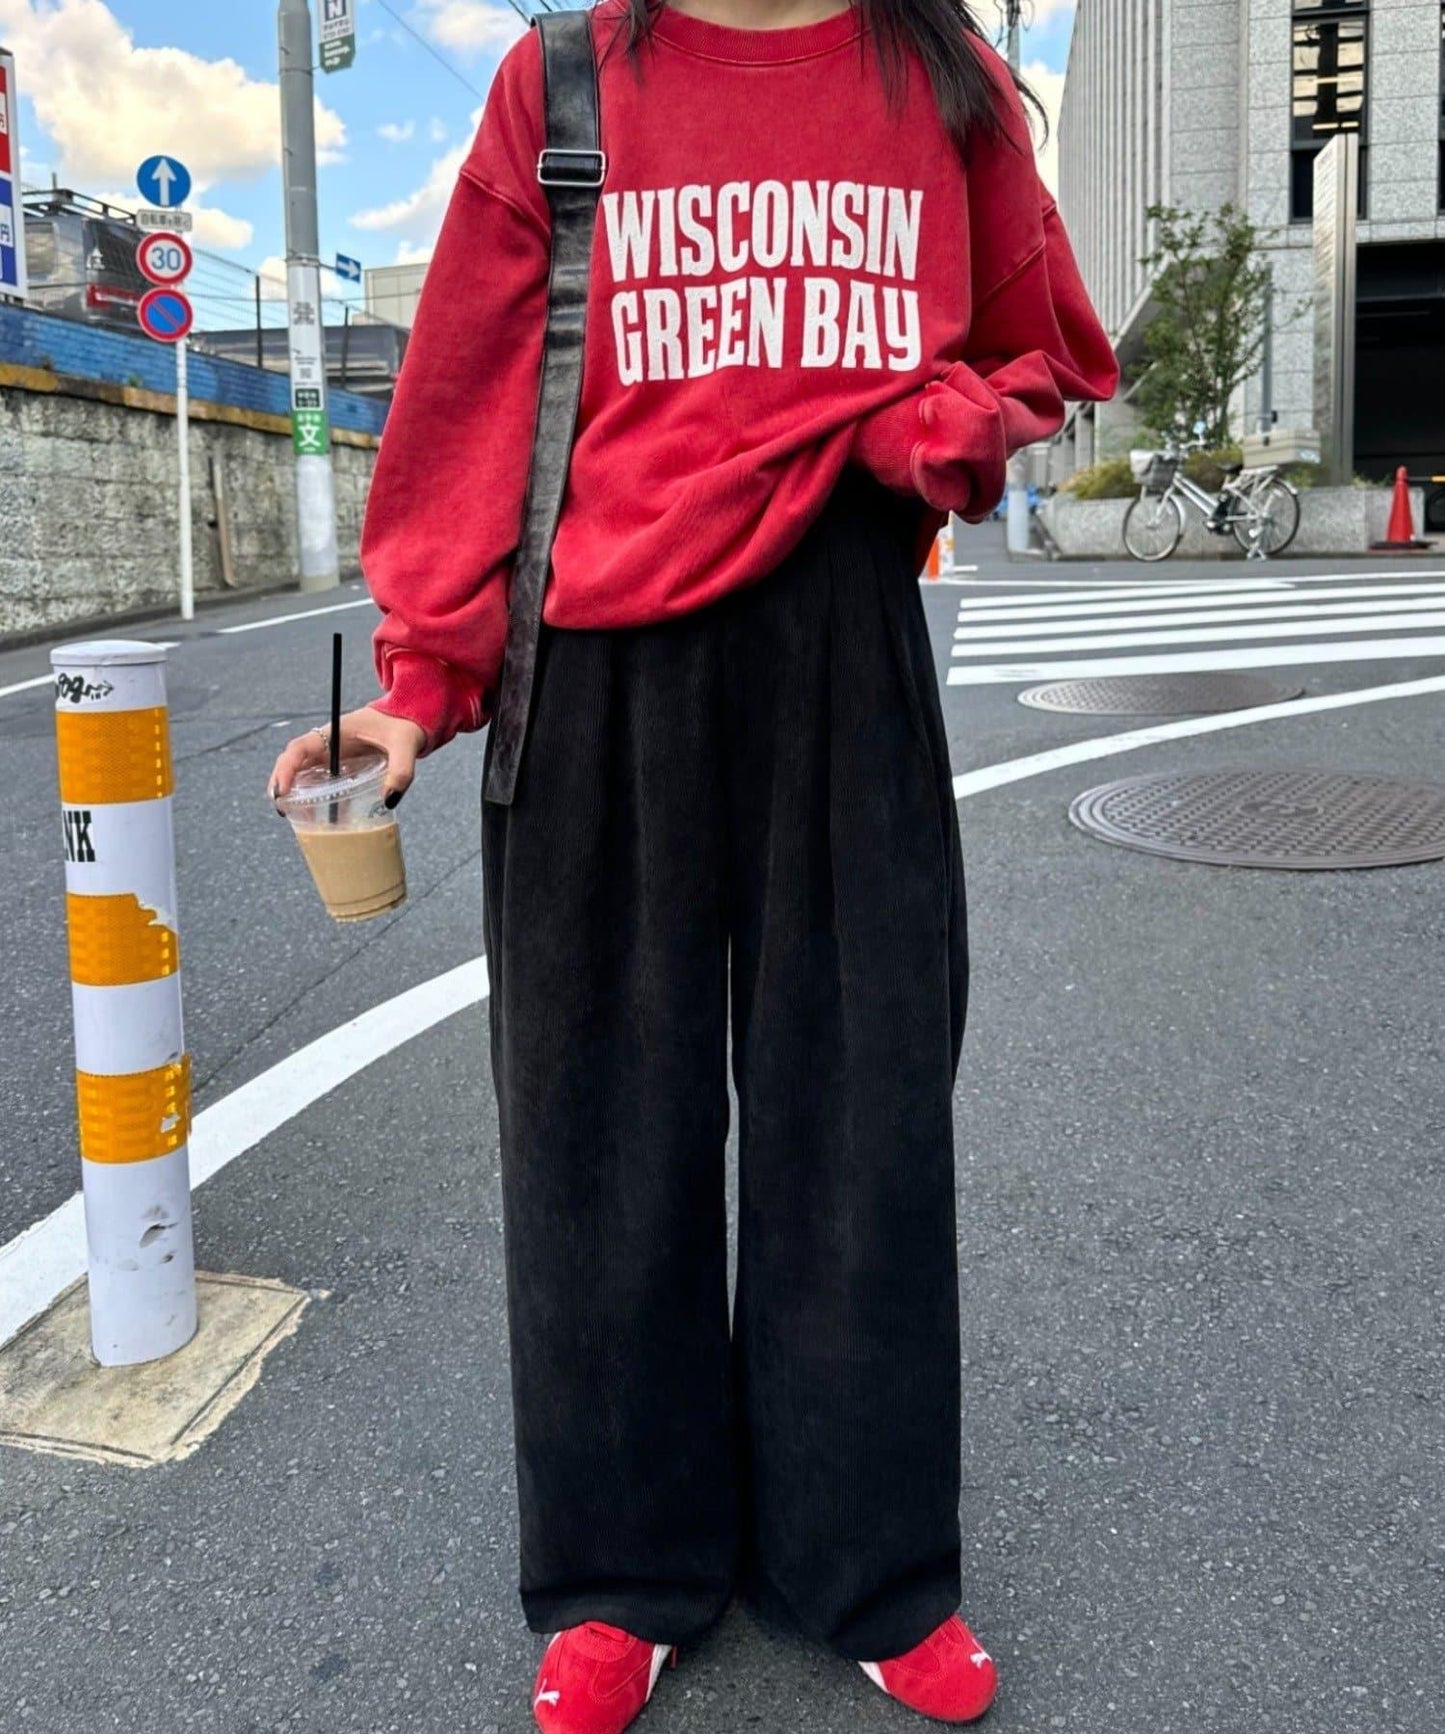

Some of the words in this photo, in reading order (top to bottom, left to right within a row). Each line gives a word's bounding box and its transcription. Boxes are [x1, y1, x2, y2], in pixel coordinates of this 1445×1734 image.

[151, 247, 181, 271] 30
[602, 180, 924, 283] WISCONSIN
[611, 277, 787, 387] GREEN
[800, 277, 923, 372] BAY
